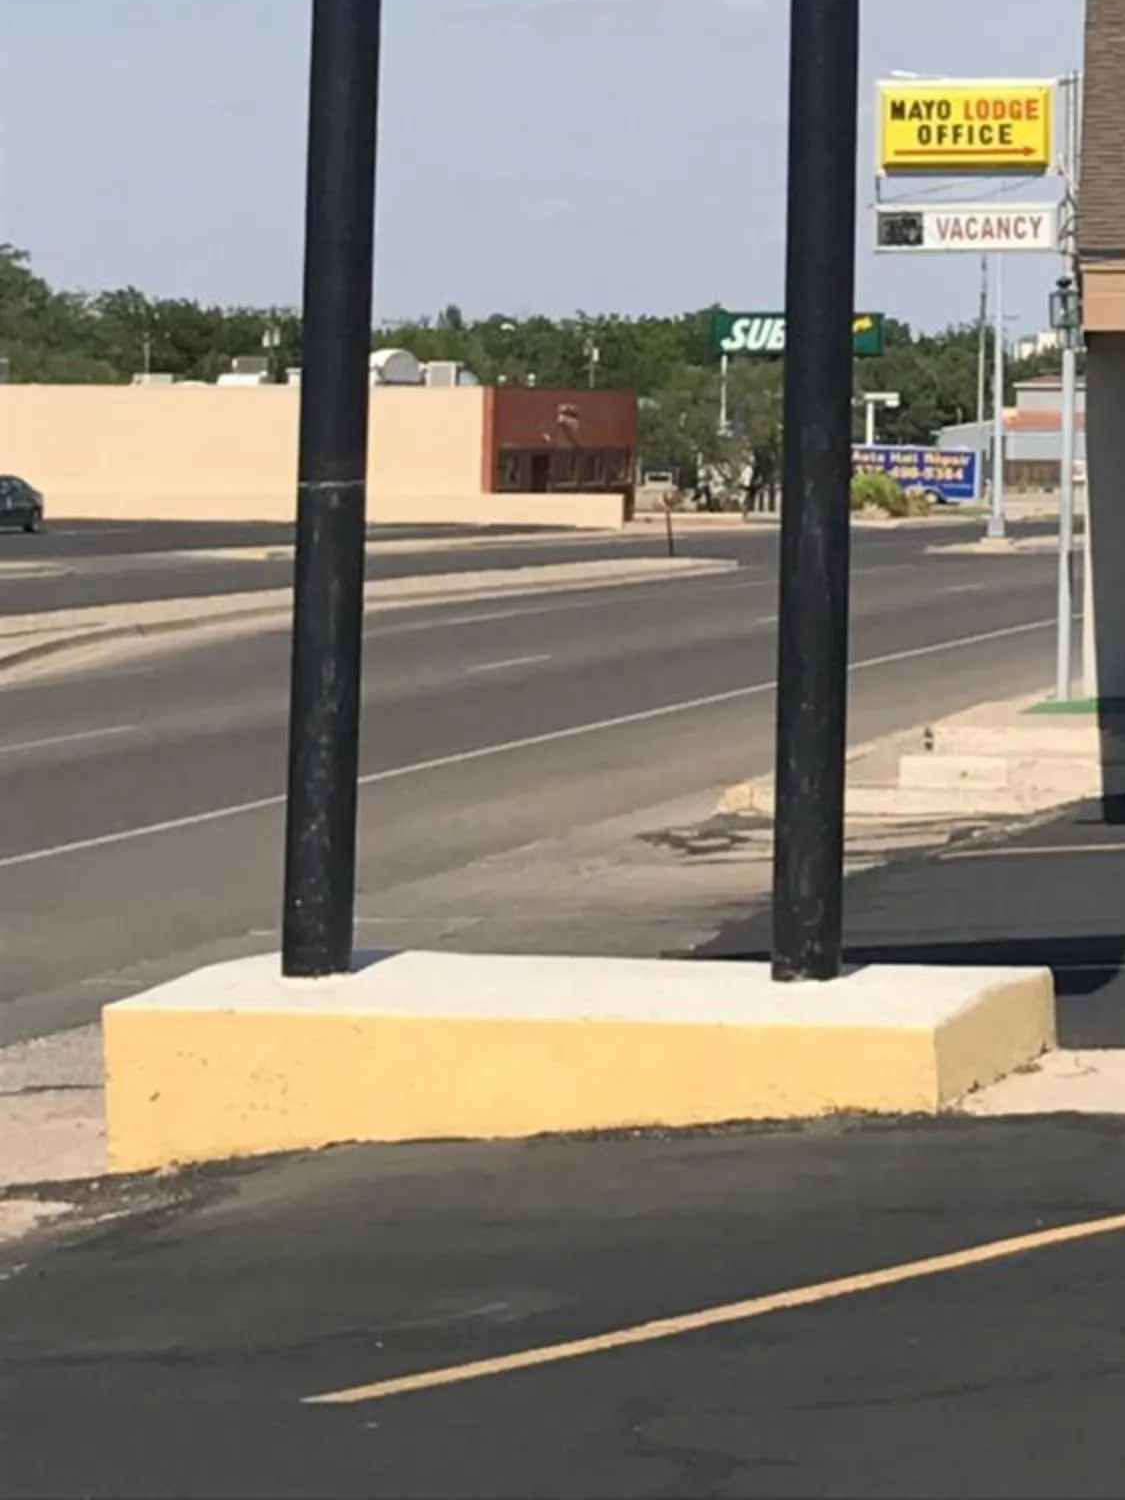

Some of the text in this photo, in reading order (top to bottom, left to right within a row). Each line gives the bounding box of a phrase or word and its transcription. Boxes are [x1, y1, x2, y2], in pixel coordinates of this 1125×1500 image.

[890, 98, 1040, 121] MAYO LODGE
[917, 124, 1013, 146] OFFICE
[936, 216, 1043, 241] VACANCY
[720, 317, 787, 351] SUB
